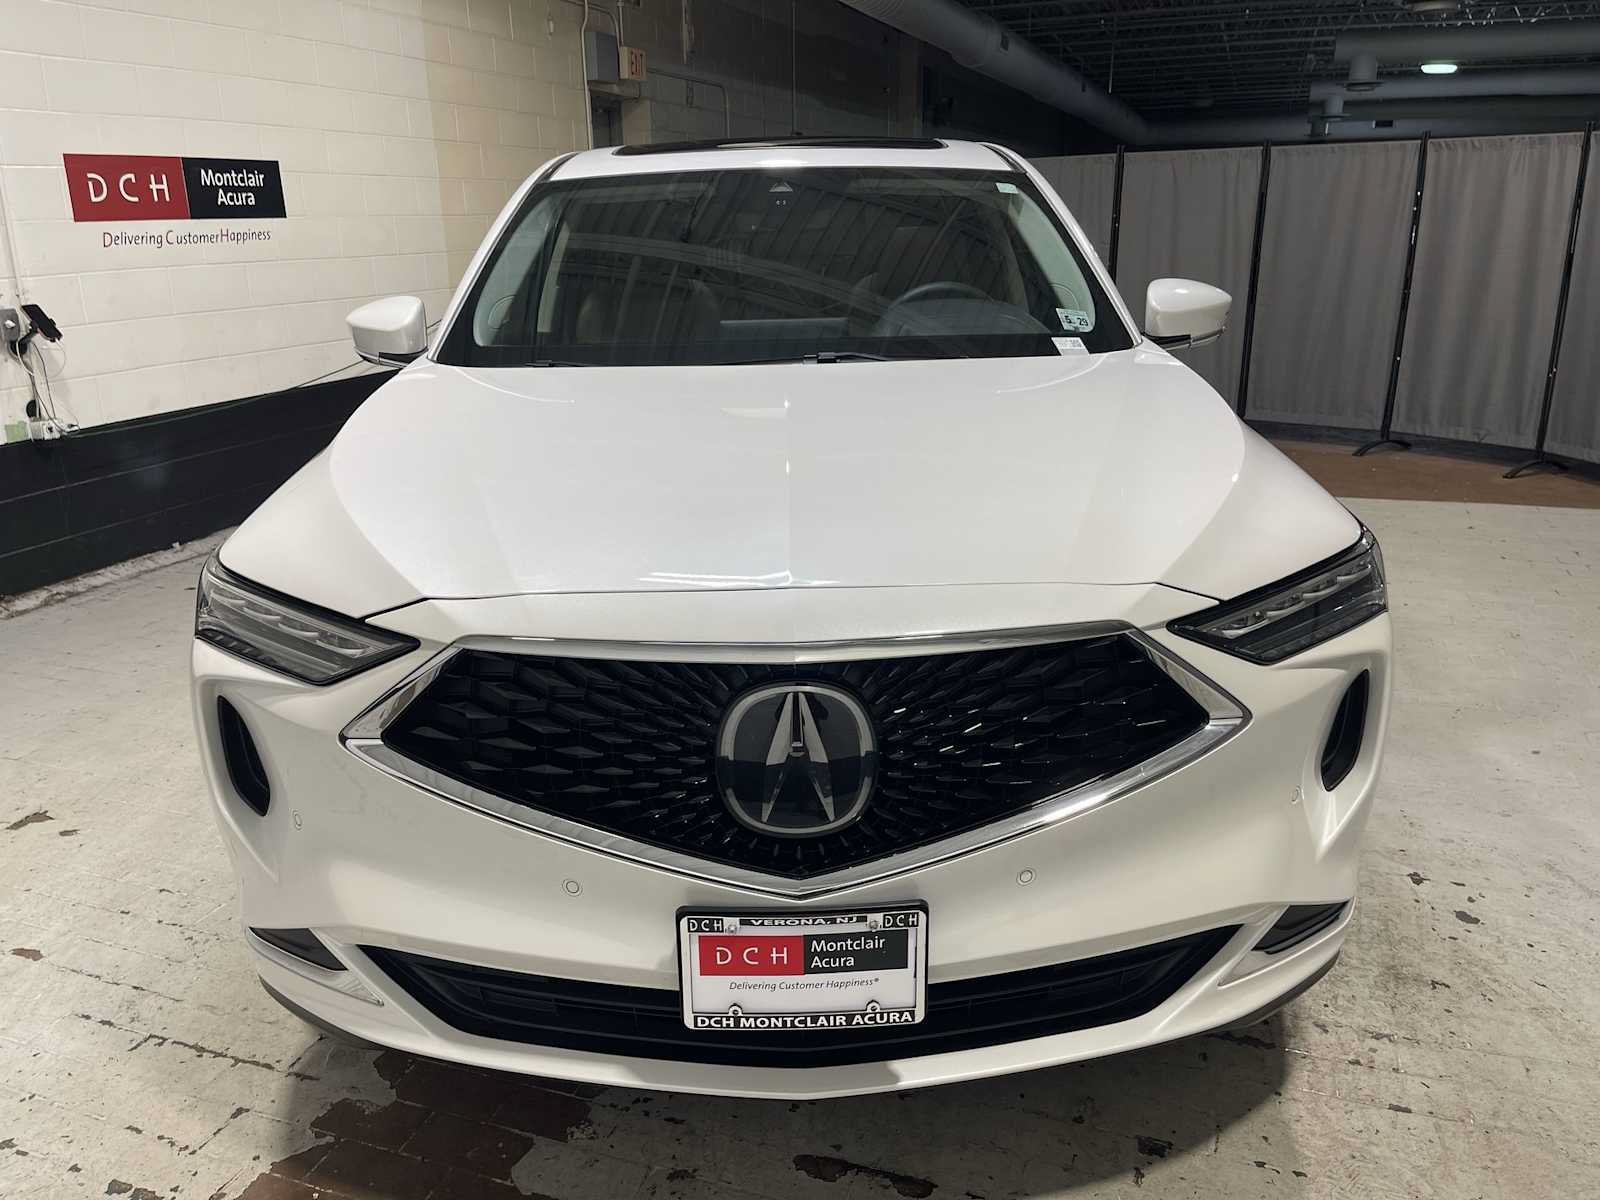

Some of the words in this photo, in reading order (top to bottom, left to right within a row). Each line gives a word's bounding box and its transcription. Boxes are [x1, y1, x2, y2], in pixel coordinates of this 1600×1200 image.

[630, 50, 643, 75] EXIT
[200, 168, 265, 187] Montclair
[217, 188, 256, 206] Acura
[103, 231, 163, 248] Delivering
[750, 917, 831, 927] VERONA,
[810, 936, 885, 953] Montclair
[810, 954, 855, 968] Acura
[729, 981, 777, 992] Delivering
[778, 980, 824, 991] Customer
[697, 1016, 735, 1028] DCH
[739, 1014, 848, 1028] MONTCLAIR
[852, 1011, 913, 1025] ACURA
